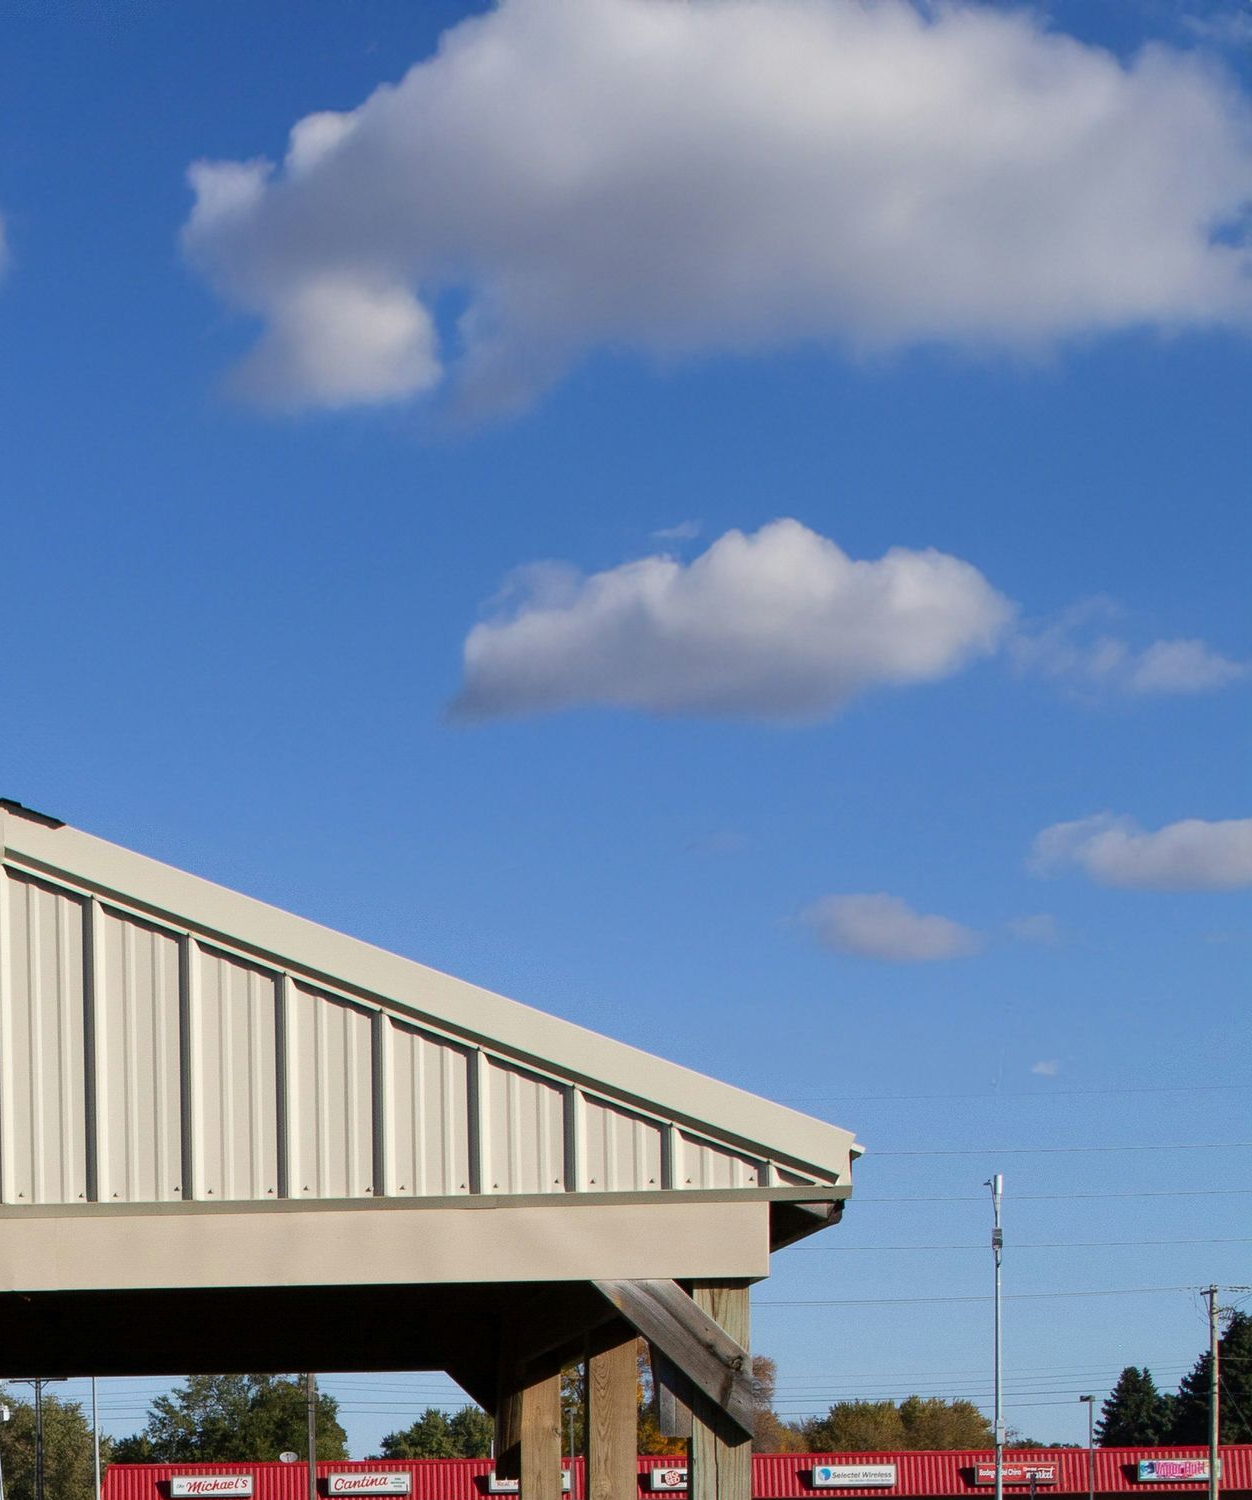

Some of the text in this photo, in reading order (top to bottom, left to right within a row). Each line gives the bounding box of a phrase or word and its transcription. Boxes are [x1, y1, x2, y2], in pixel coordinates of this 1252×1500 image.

[979, 1469, 996, 1478] Bodeg
[186, 1478, 248, 1493] Michael's
[334, 1476, 388, 1491] Cantina
